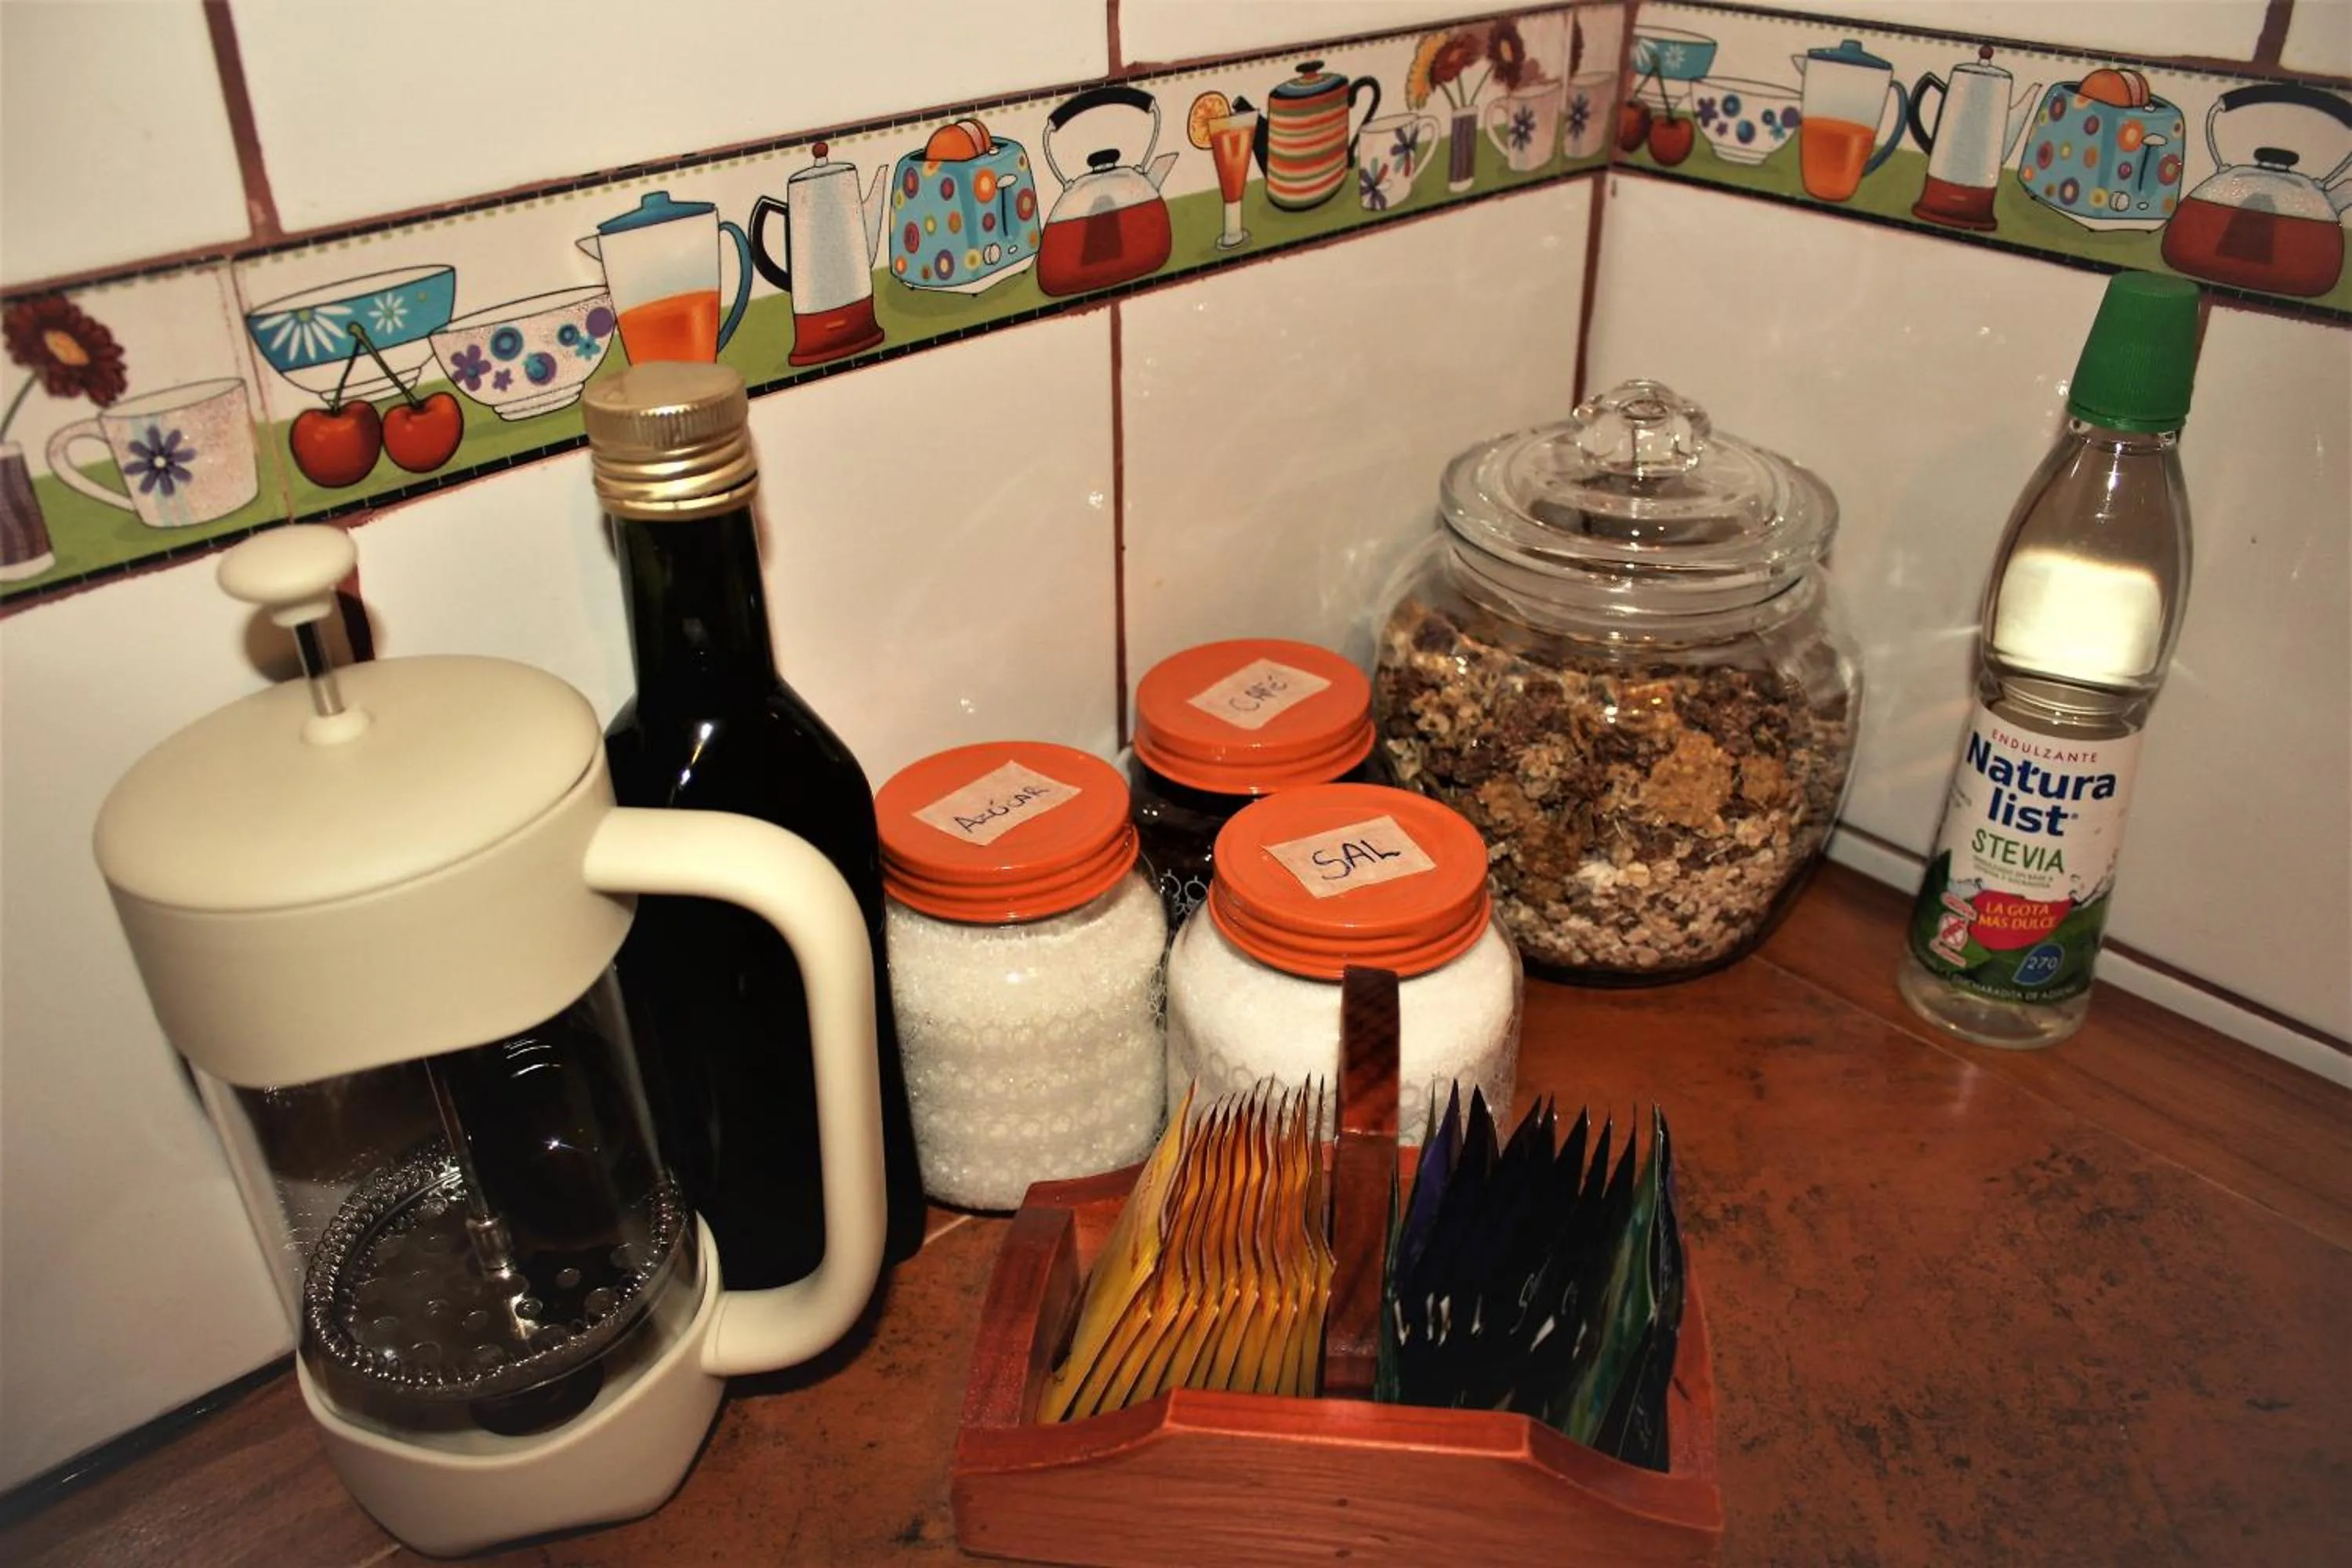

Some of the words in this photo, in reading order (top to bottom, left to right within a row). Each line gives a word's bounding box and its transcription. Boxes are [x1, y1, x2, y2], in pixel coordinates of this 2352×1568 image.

[1991, 728, 2098, 763] ENDULZANTE
[1966, 731, 2117, 800] Natura
[1987, 786, 2069, 837] list
[1312, 840, 1401, 880] SAL
[1971, 828, 2065, 875] STEVIA
[1985, 902, 2003, 914] LA
[2006, 904, 2049, 916] GOTA
[2010, 916, 2056, 931] DULCE
[2027, 956, 2059, 971] 270
